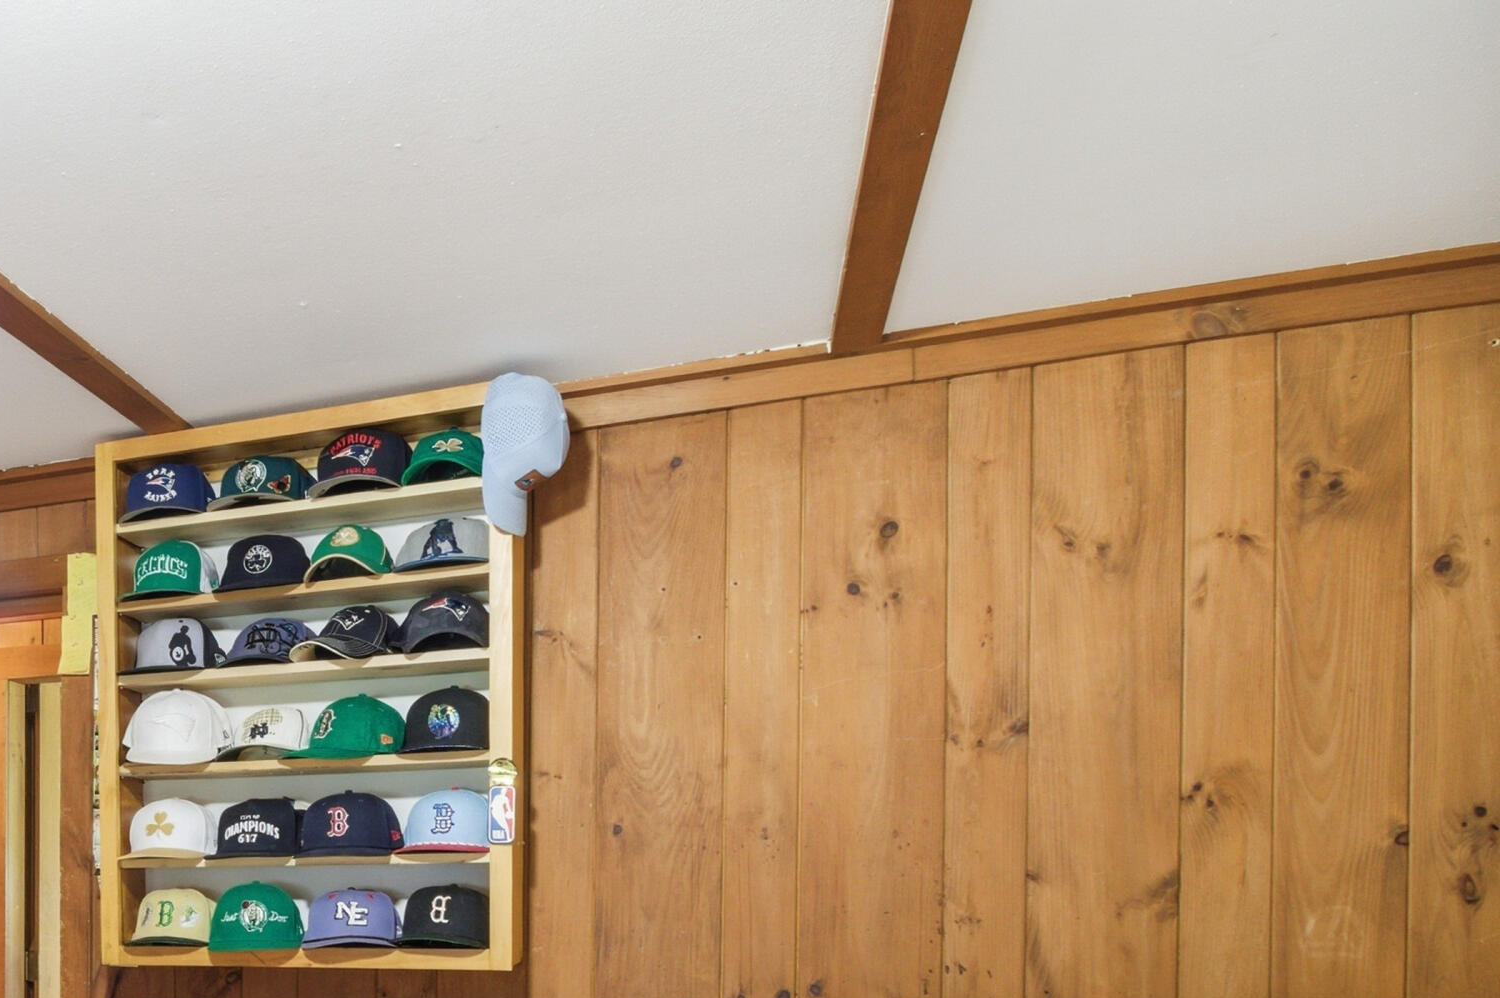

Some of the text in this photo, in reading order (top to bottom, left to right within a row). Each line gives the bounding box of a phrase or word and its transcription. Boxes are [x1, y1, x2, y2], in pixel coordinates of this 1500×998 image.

[330, 433, 382, 455] PATRIOTS
[136, 553, 188, 586] CELTICS
[224, 820, 280, 841] CHAMPIONS
[327, 806, 349, 838] B
[430, 803, 455, 835] B
[237, 833, 257, 844] 617
[155, 900, 176, 928] B
[334, 901, 369, 926] NE
